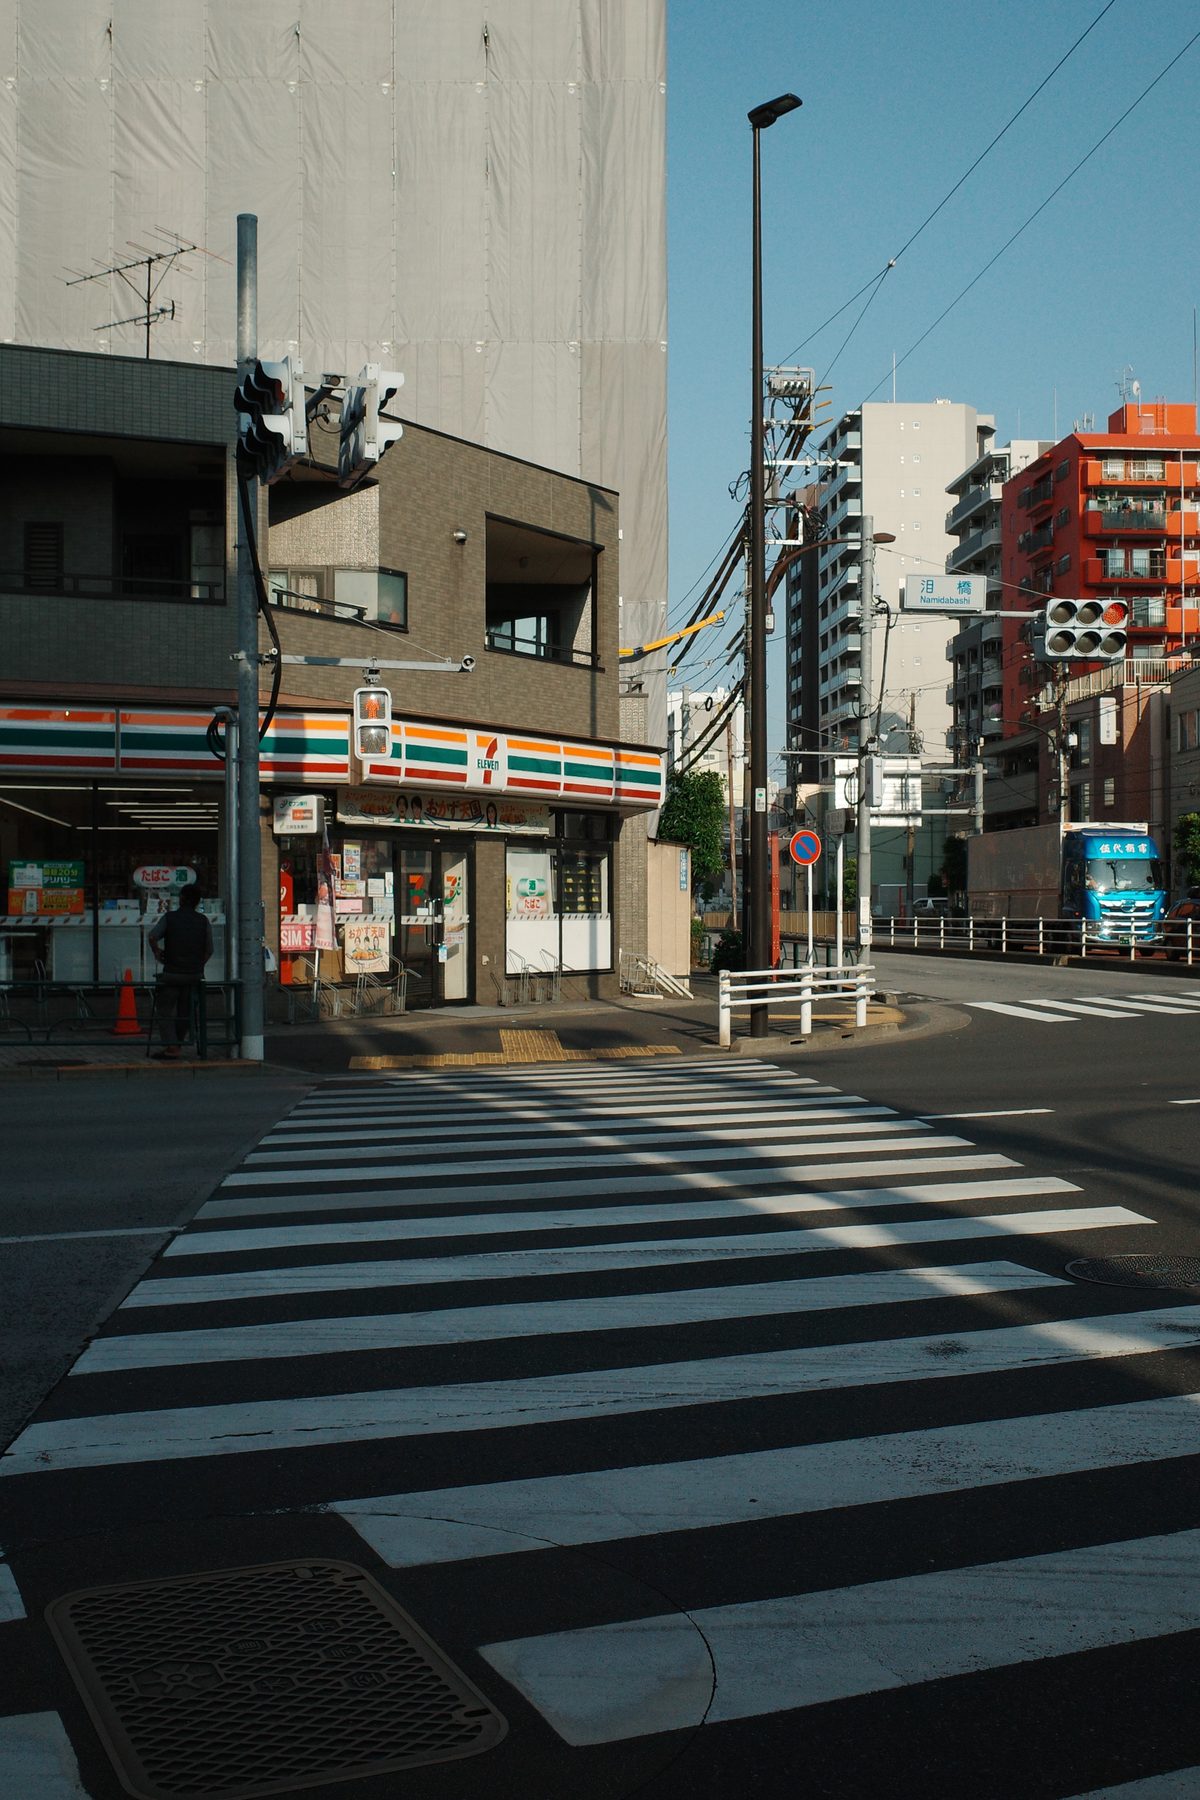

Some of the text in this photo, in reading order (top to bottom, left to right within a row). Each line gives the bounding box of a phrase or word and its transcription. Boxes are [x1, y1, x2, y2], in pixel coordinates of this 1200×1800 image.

[920, 596, 970, 605] Namidabashi
[141, 869, 170, 882] たばこ
[524, 898, 541, 909] たばこ
[280, 929, 302, 947] SIM
[348, 926, 386, 940] おかず天国
